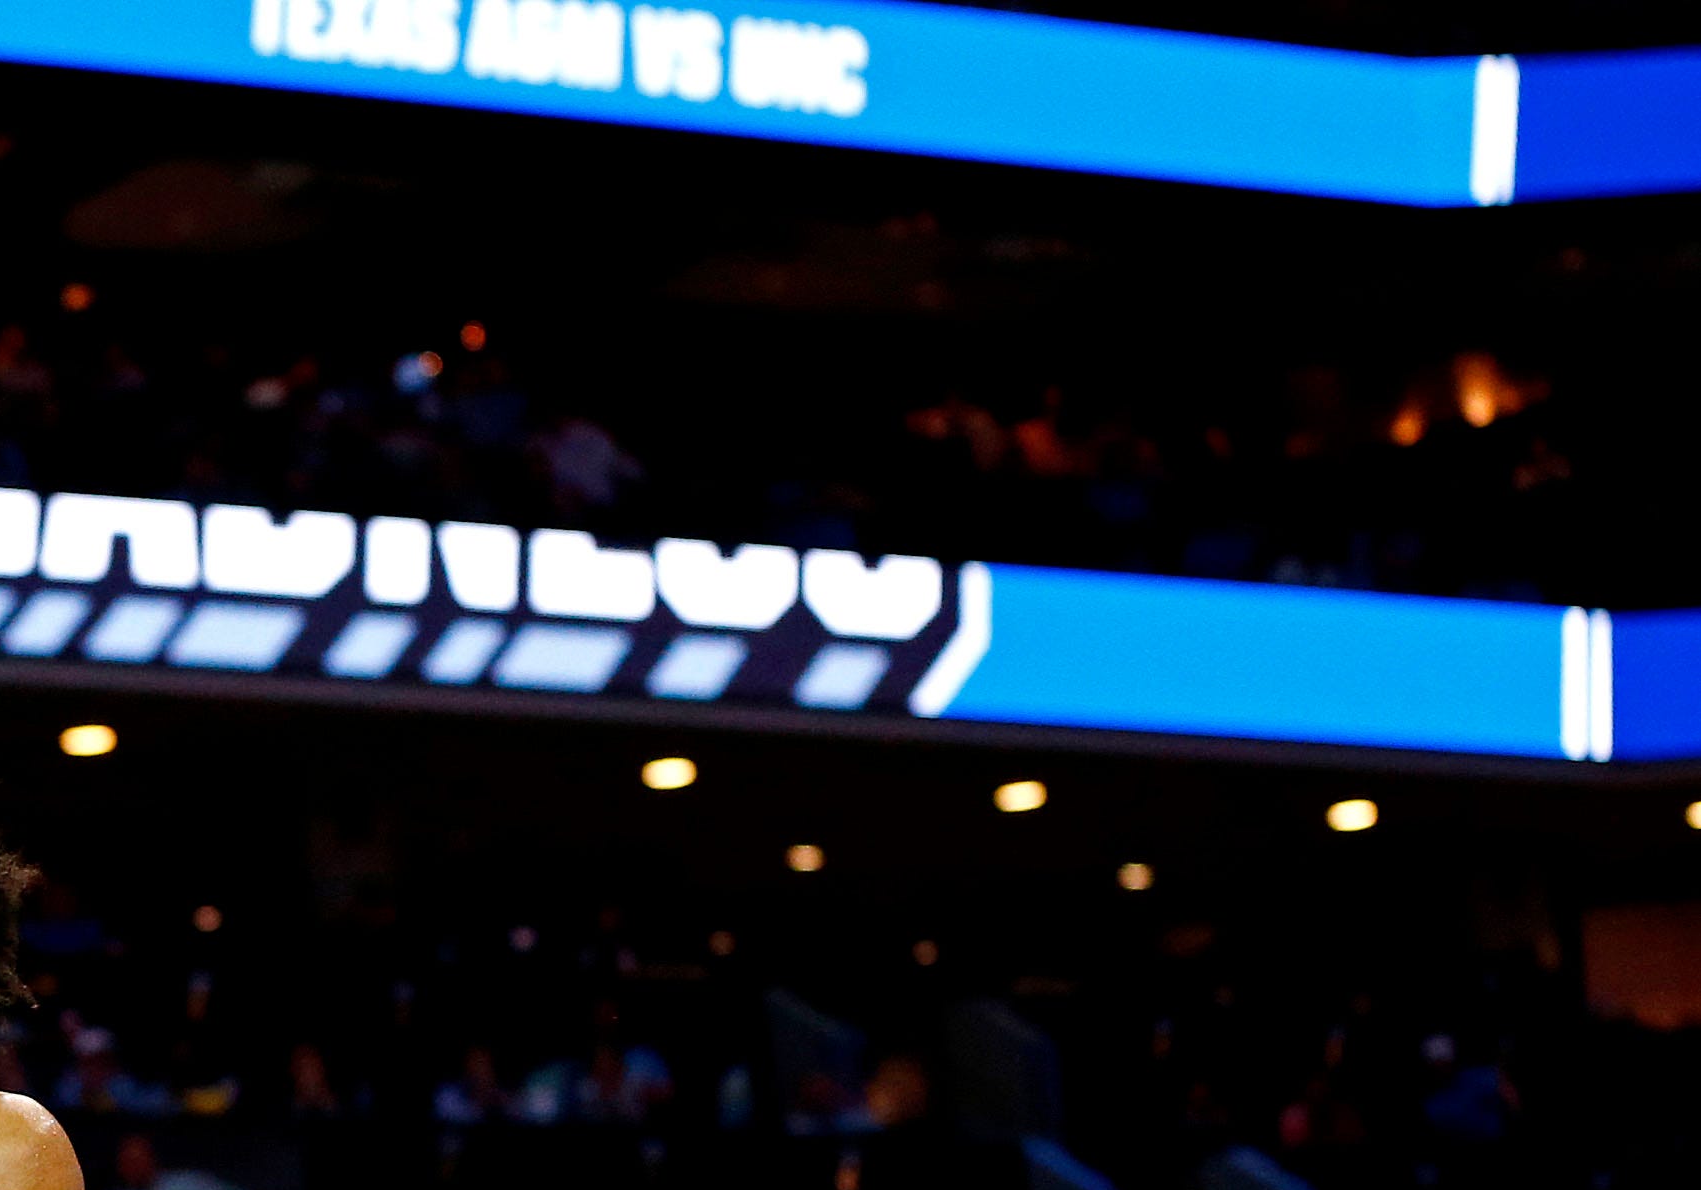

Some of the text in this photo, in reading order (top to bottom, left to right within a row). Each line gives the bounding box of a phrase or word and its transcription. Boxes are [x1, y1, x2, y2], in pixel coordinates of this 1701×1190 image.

[250, 0, 460, 73] TEXAS
[630, 5, 723, 101] VS
[728, 16, 868, 116] UNC
